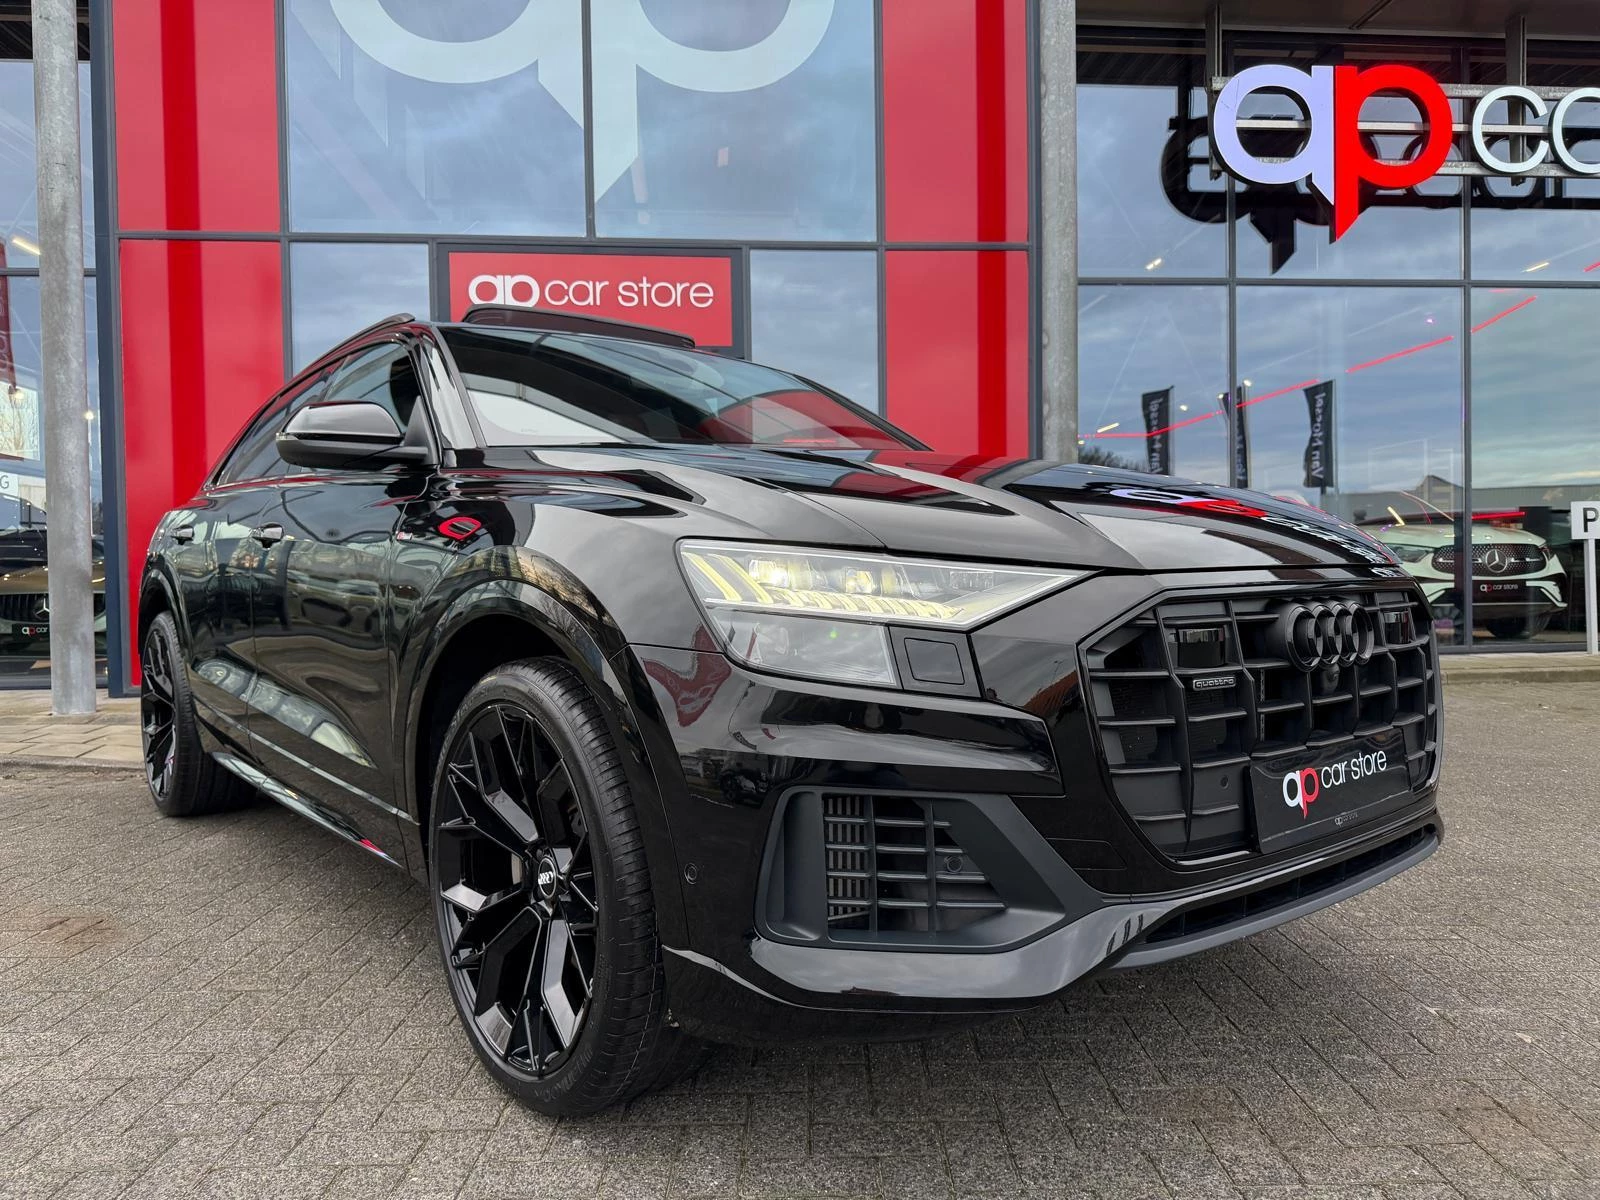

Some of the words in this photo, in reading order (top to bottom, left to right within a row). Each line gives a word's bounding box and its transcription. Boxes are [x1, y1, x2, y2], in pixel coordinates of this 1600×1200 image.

[1213, 64, 1453, 241] ap
[544, 279, 609, 306] car
[617, 276, 714, 308] store
[1195, 678, 1234, 688] quattro
[1282, 767, 1320, 820] ap
[1321, 760, 1348, 789] car
[1350, 750, 1387, 780] store
